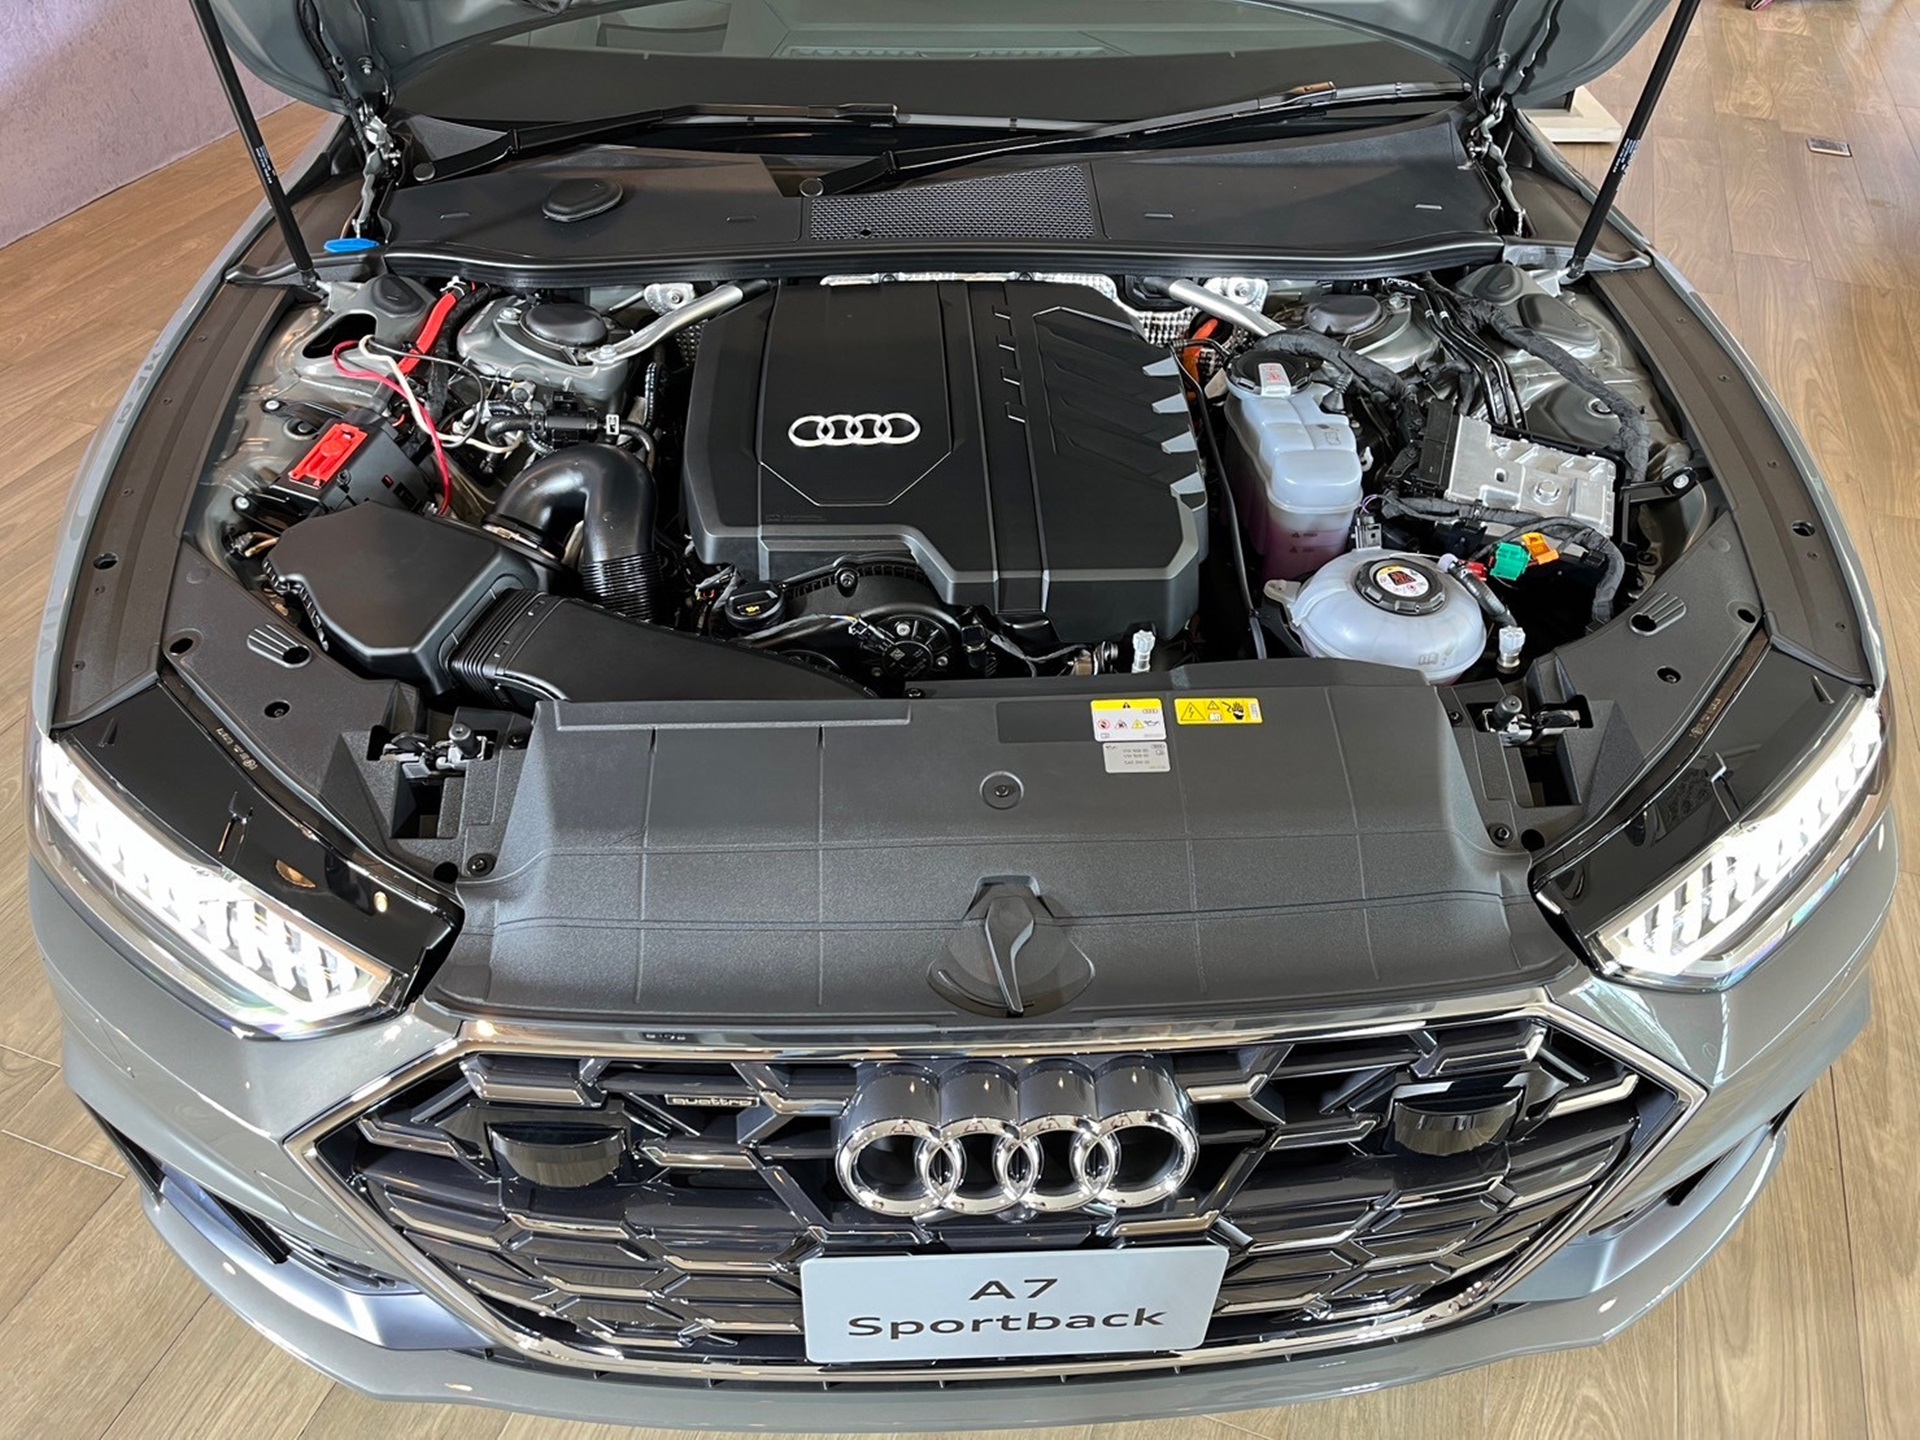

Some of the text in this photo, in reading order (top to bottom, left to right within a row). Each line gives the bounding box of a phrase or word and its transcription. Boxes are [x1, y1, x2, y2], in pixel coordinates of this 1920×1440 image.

[672, 1097, 752, 1106] quattro
[969, 1278, 1058, 1300] A7
[848, 1308, 1168, 1339] Sportback
